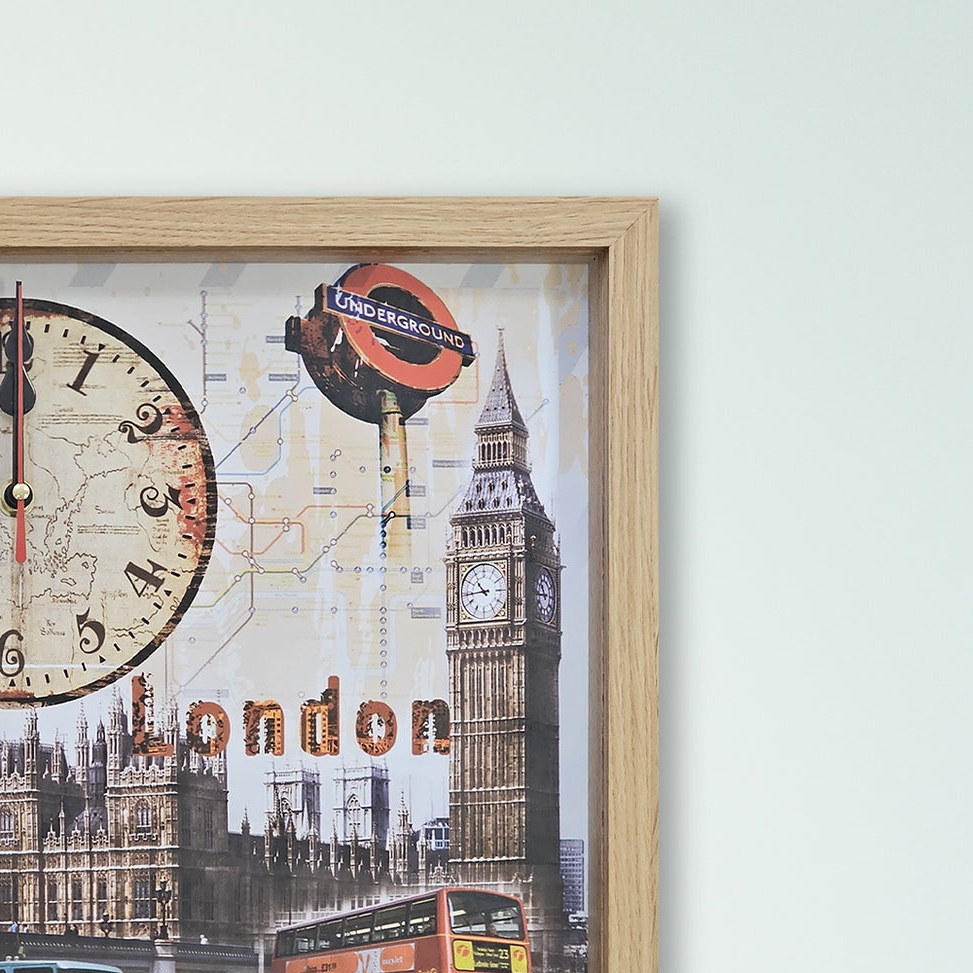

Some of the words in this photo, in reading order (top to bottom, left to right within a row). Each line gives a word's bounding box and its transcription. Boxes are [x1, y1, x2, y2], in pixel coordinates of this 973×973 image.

[335, 291, 465, 349] UNDERGROUND
[67, 350, 100, 396] 1
[118, 403, 163, 443] 2
[140, 483, 183, 517] 3
[124, 559, 165, 598] 4
[76, 607, 105, 654] 5
[132, 673, 449, 757] London
